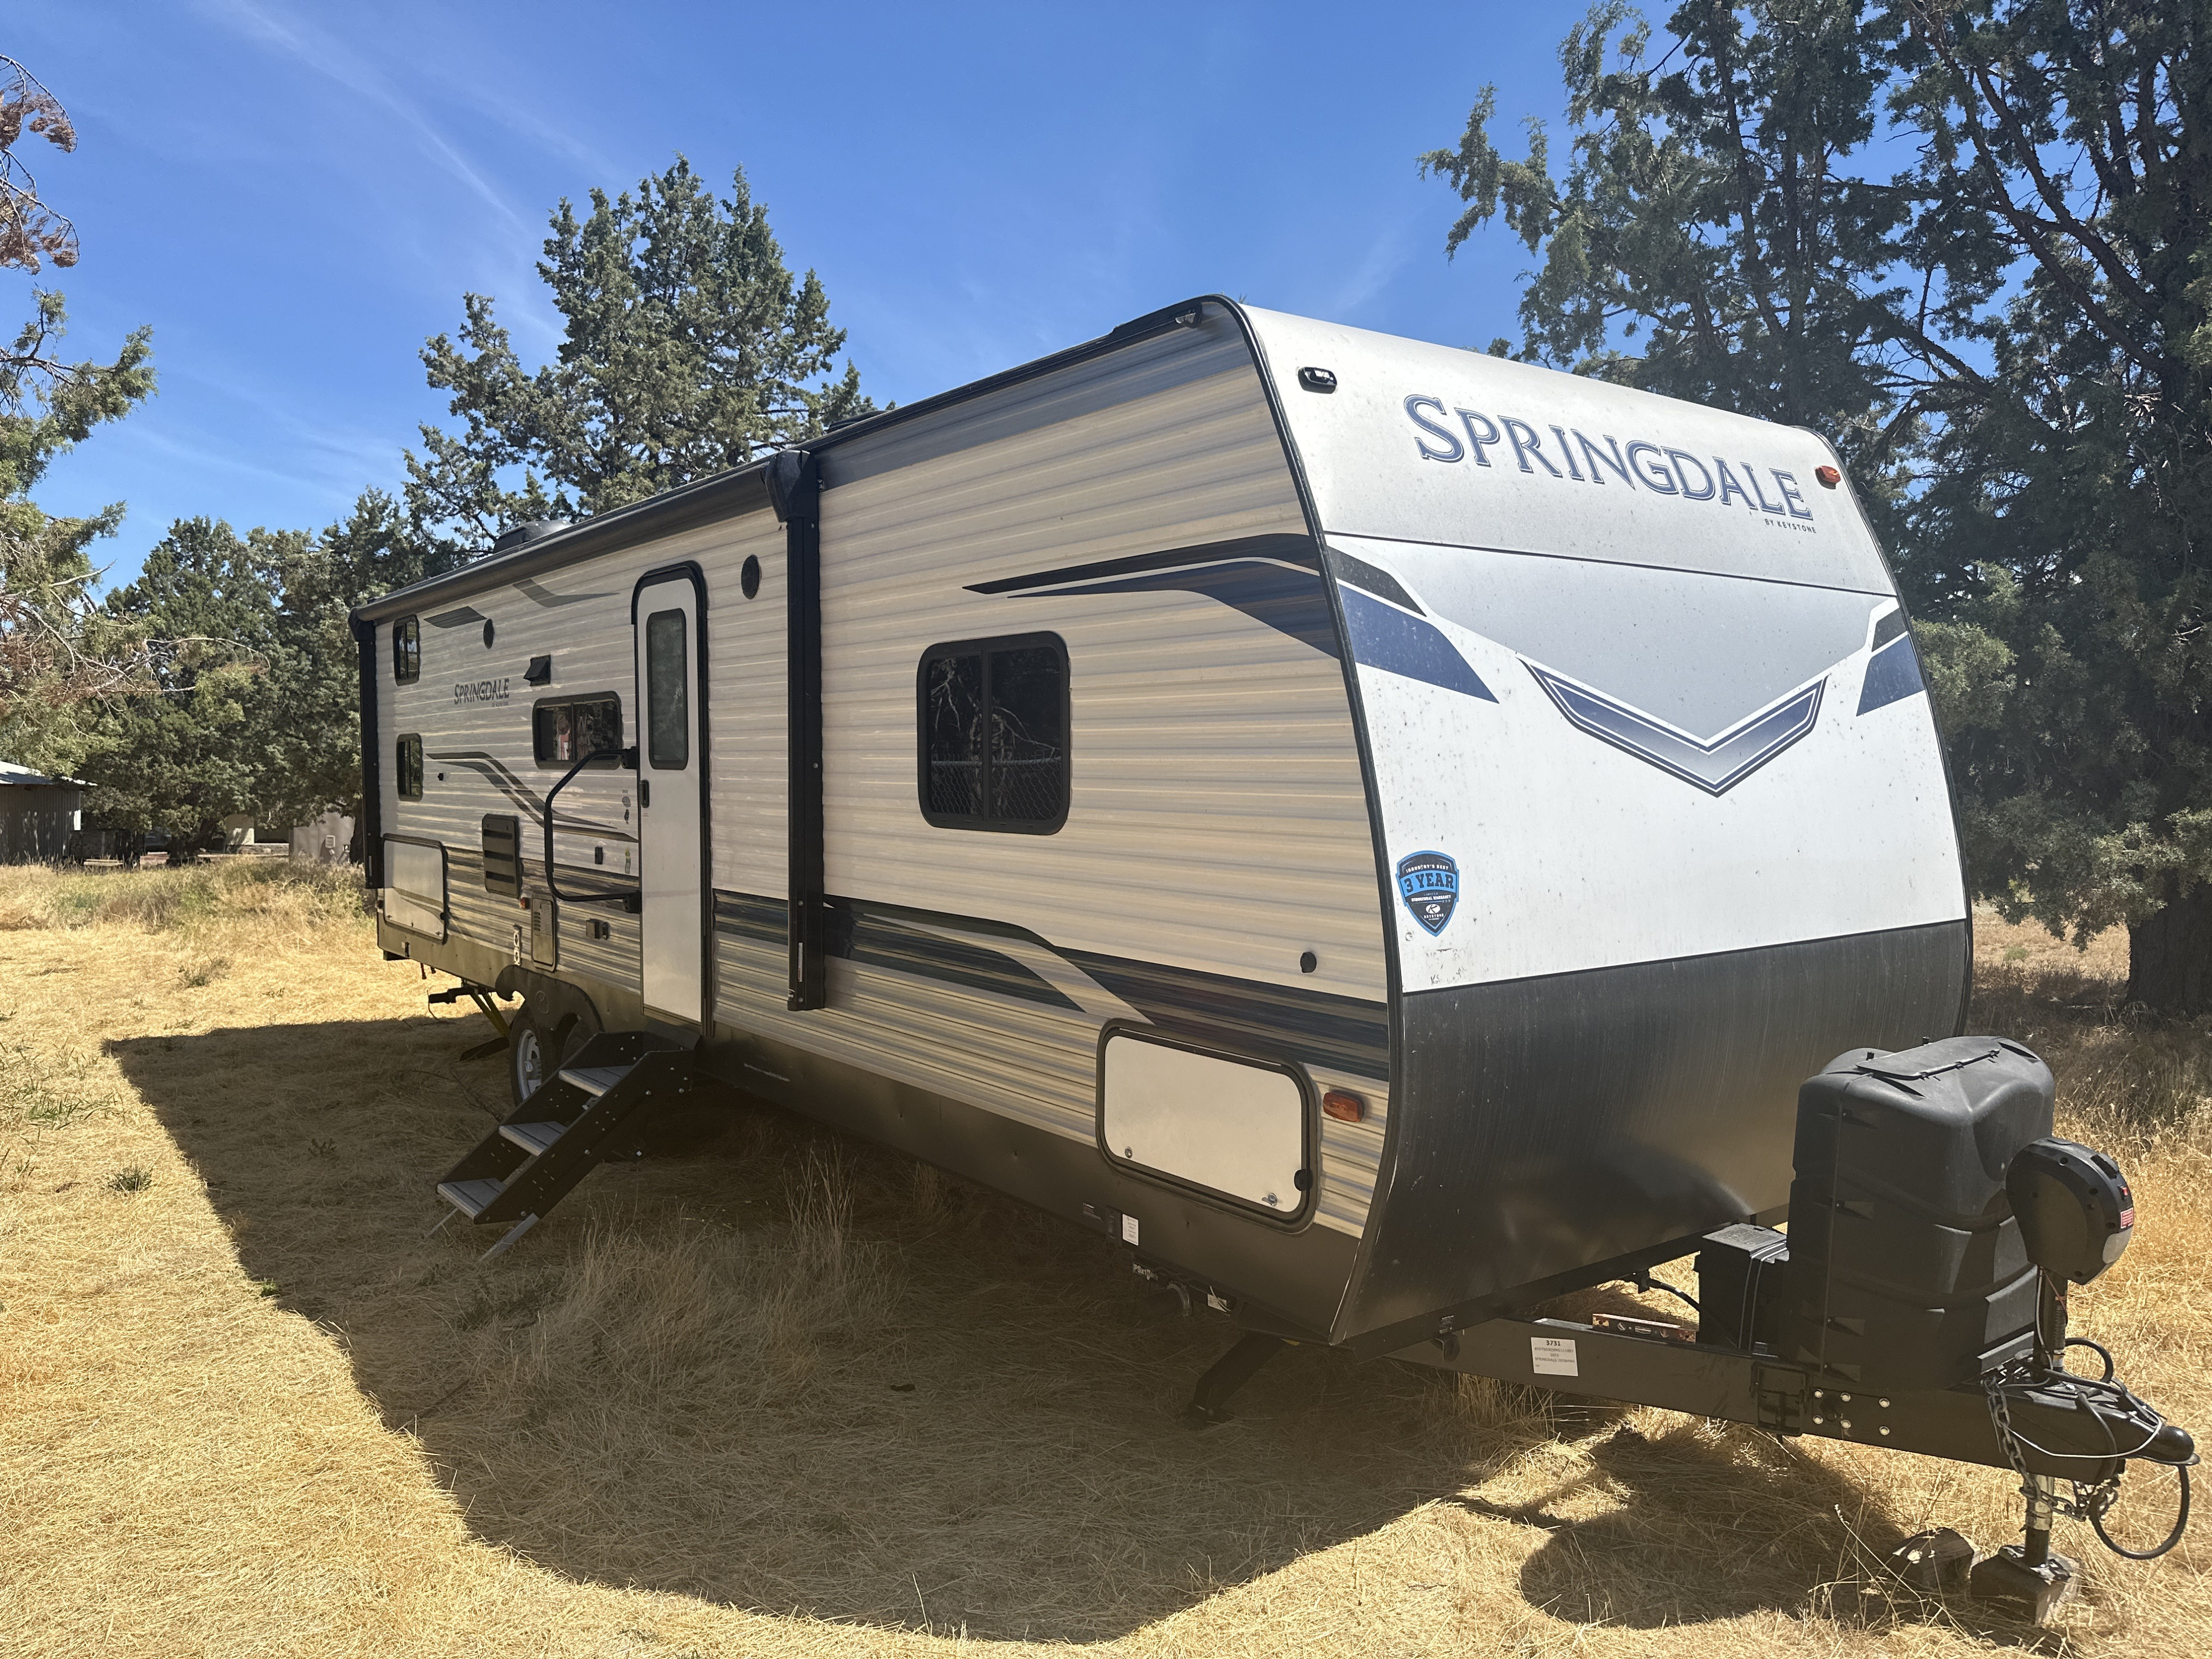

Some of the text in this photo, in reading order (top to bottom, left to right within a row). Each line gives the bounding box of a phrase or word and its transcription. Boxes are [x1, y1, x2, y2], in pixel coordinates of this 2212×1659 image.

[1403, 394, 1814, 520] SPRINGDALE
[1777, 520, 1817, 534] KEYSTONE
[454, 678, 509, 705] SPRINGDALE
[1404, 873, 1454, 893] 3 YEAR
